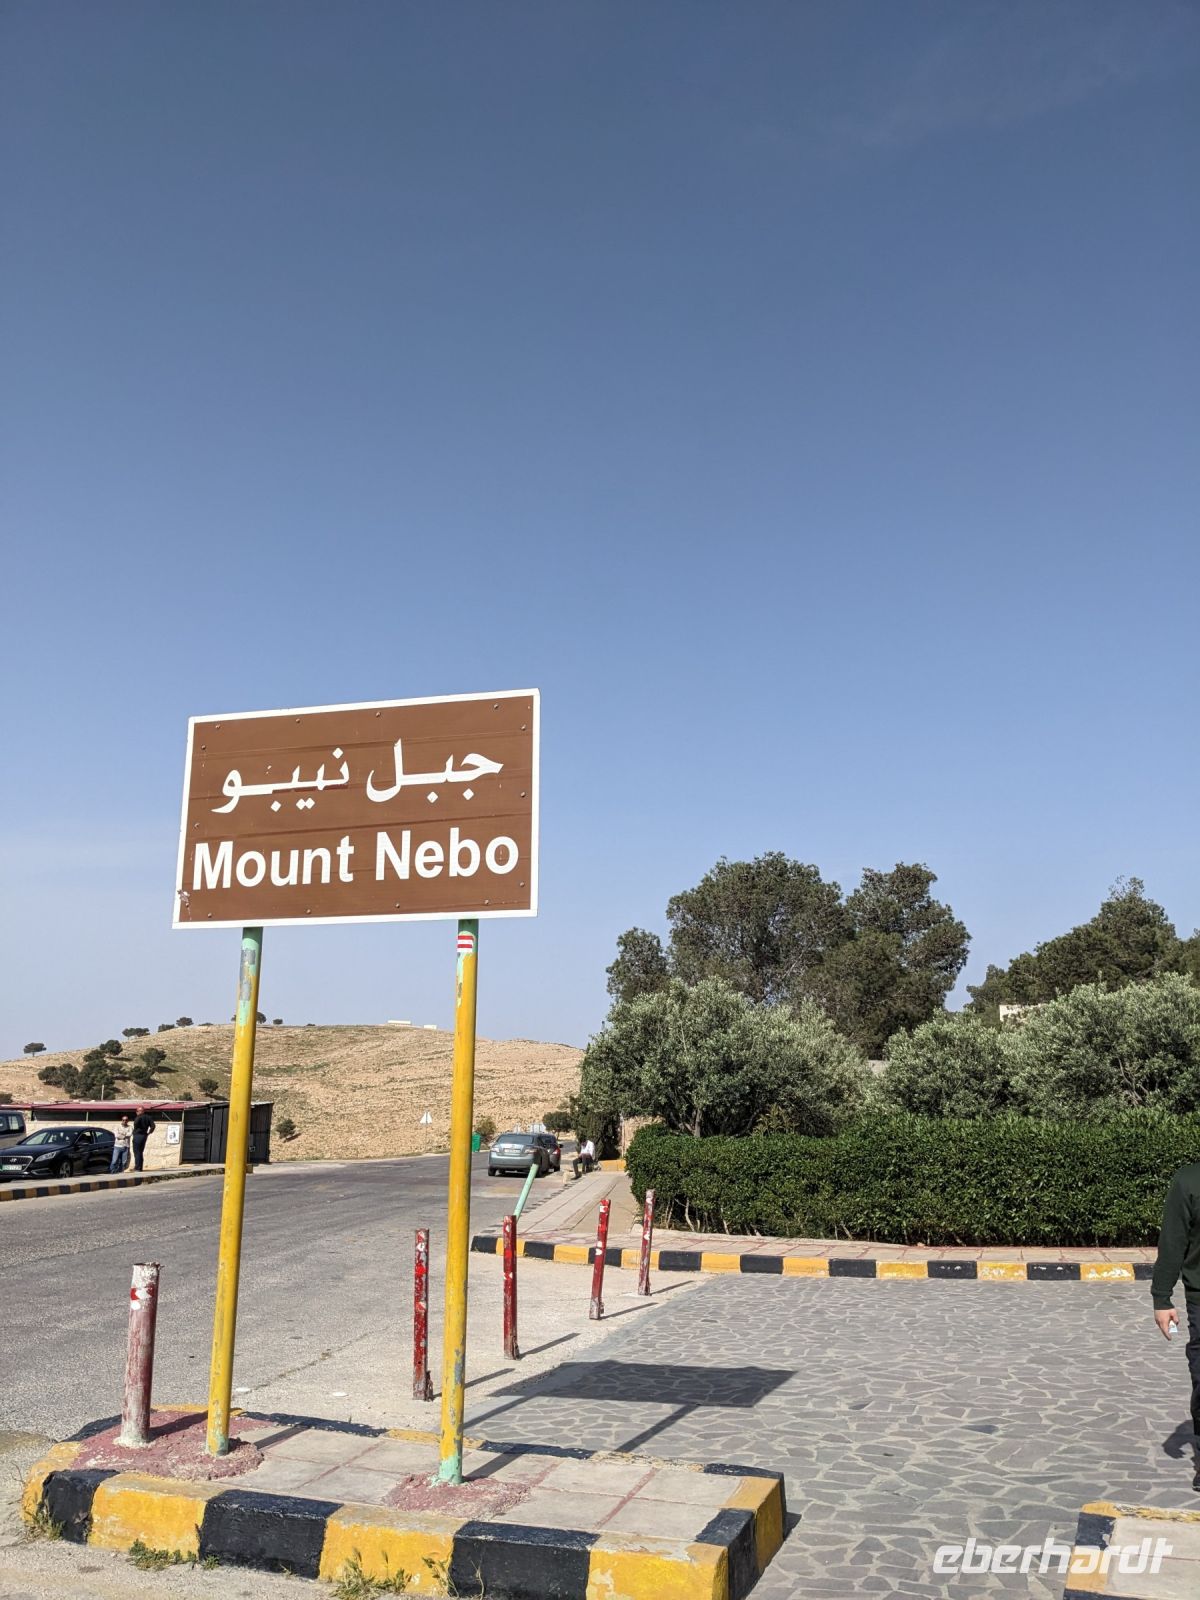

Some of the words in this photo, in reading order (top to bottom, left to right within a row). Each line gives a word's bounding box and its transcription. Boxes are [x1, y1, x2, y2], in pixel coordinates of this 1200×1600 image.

[211, 747, 350, 814] نيبو
[366, 738, 504, 803] جبل
[192, 835, 355, 891] Mount
[375, 827, 519, 881] Nebo
